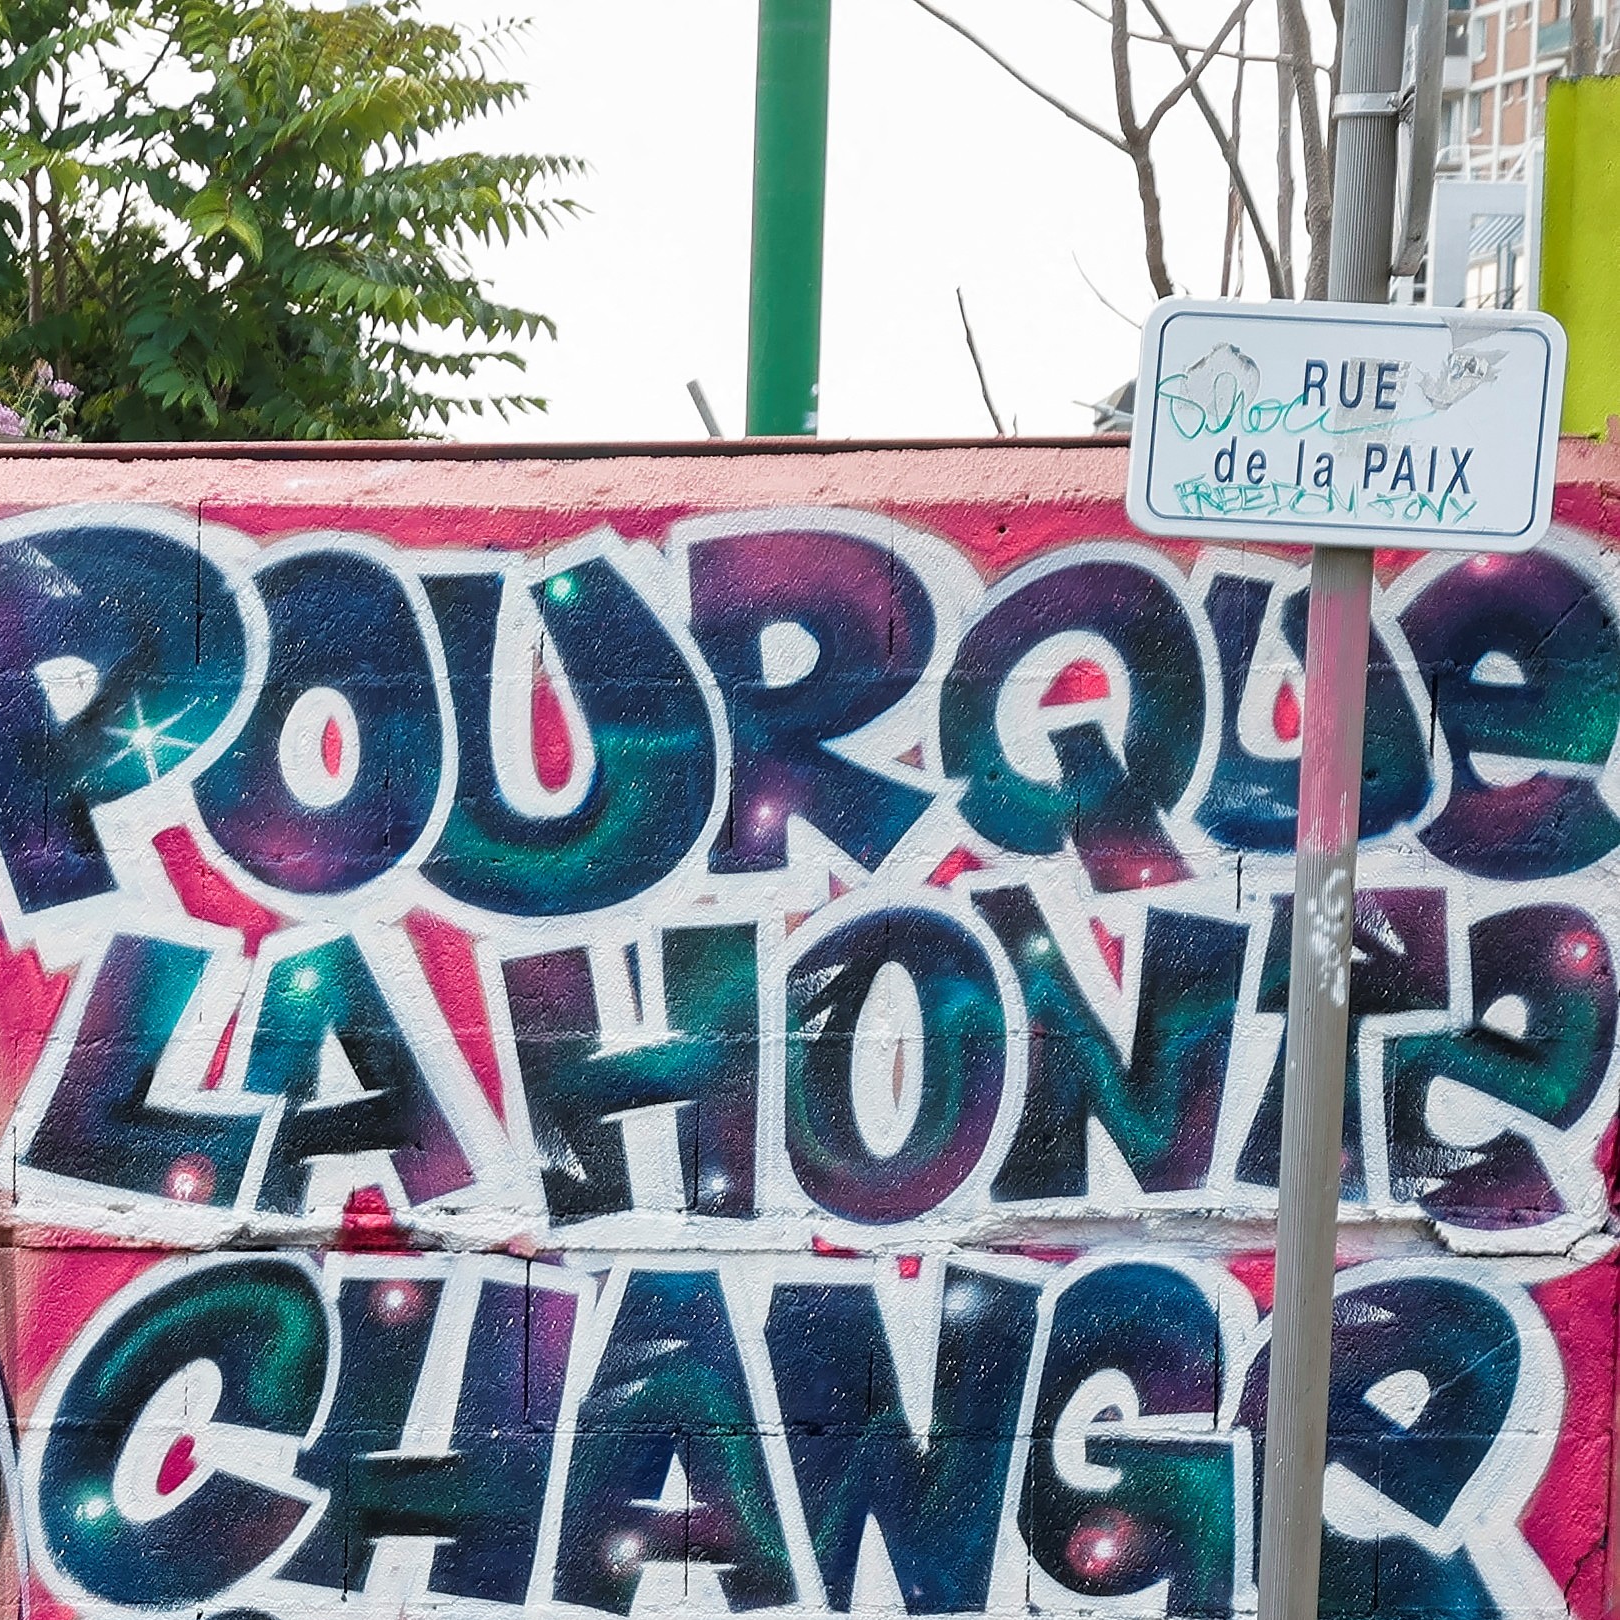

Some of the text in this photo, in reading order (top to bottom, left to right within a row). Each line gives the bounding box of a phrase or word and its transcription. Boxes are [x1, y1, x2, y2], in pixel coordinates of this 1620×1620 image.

[1301, 358, 1401, 411] RUE
[1213, 435, 1475, 495] de la PAIX
